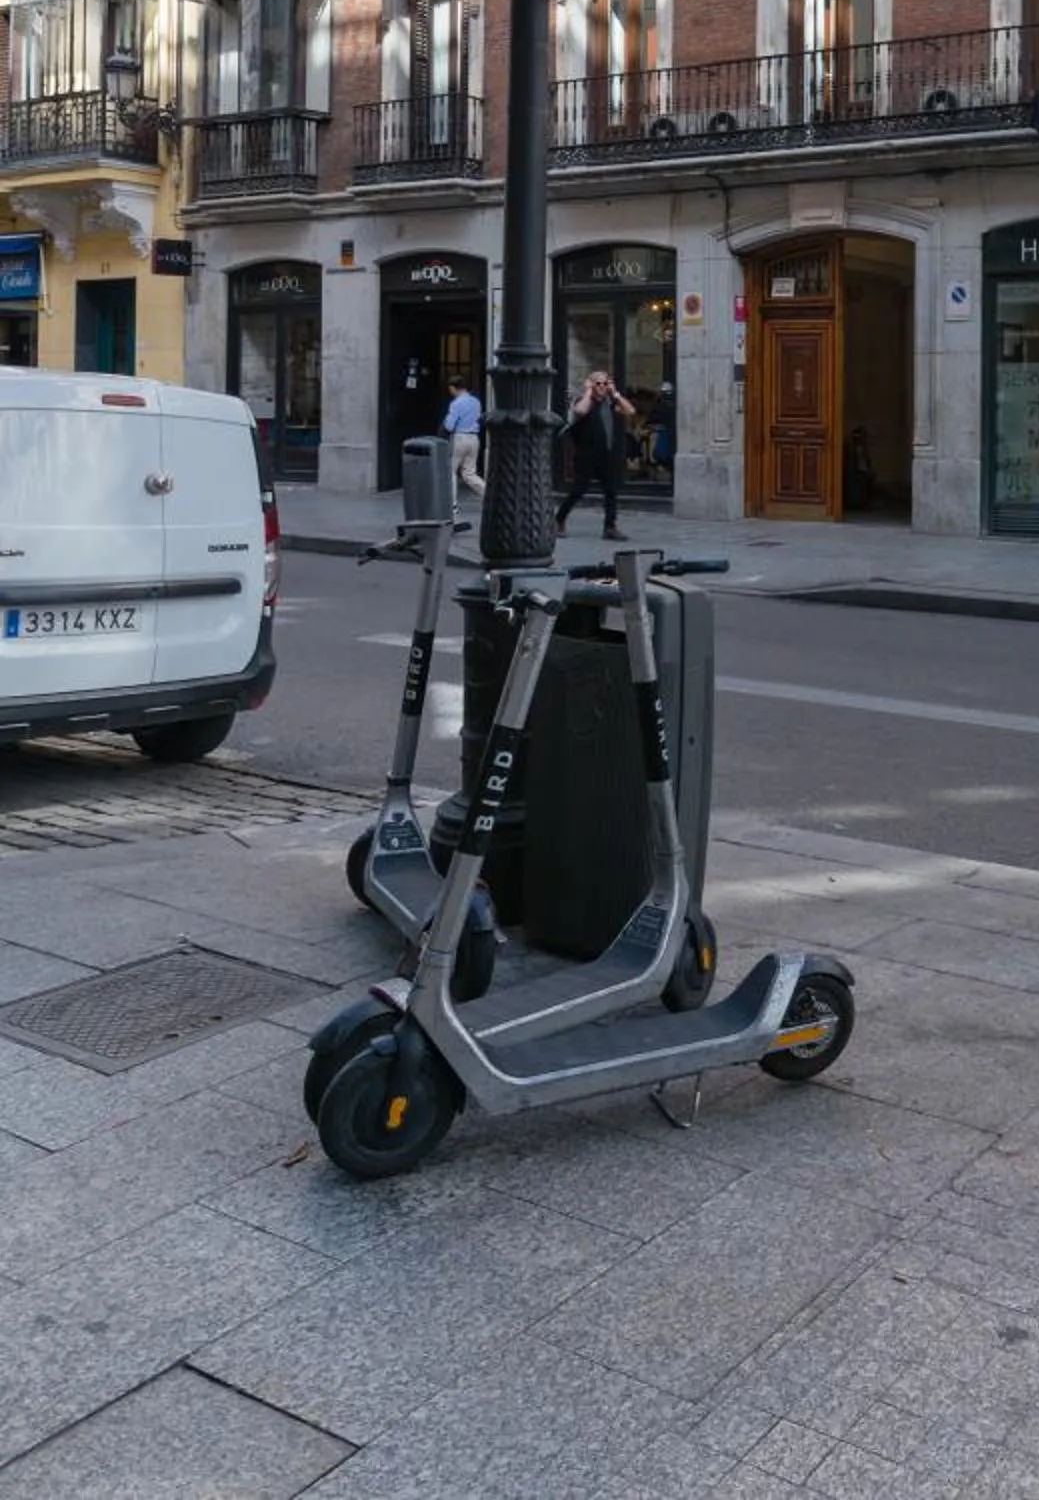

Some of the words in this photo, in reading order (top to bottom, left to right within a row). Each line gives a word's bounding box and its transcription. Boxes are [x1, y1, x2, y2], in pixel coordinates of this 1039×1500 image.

[25, 611, 85, 634] 3314
[94, 607, 137, 631] KXZ
[405, 646, 423, 701] BIRD
[473, 750, 514, 833] BIRD
